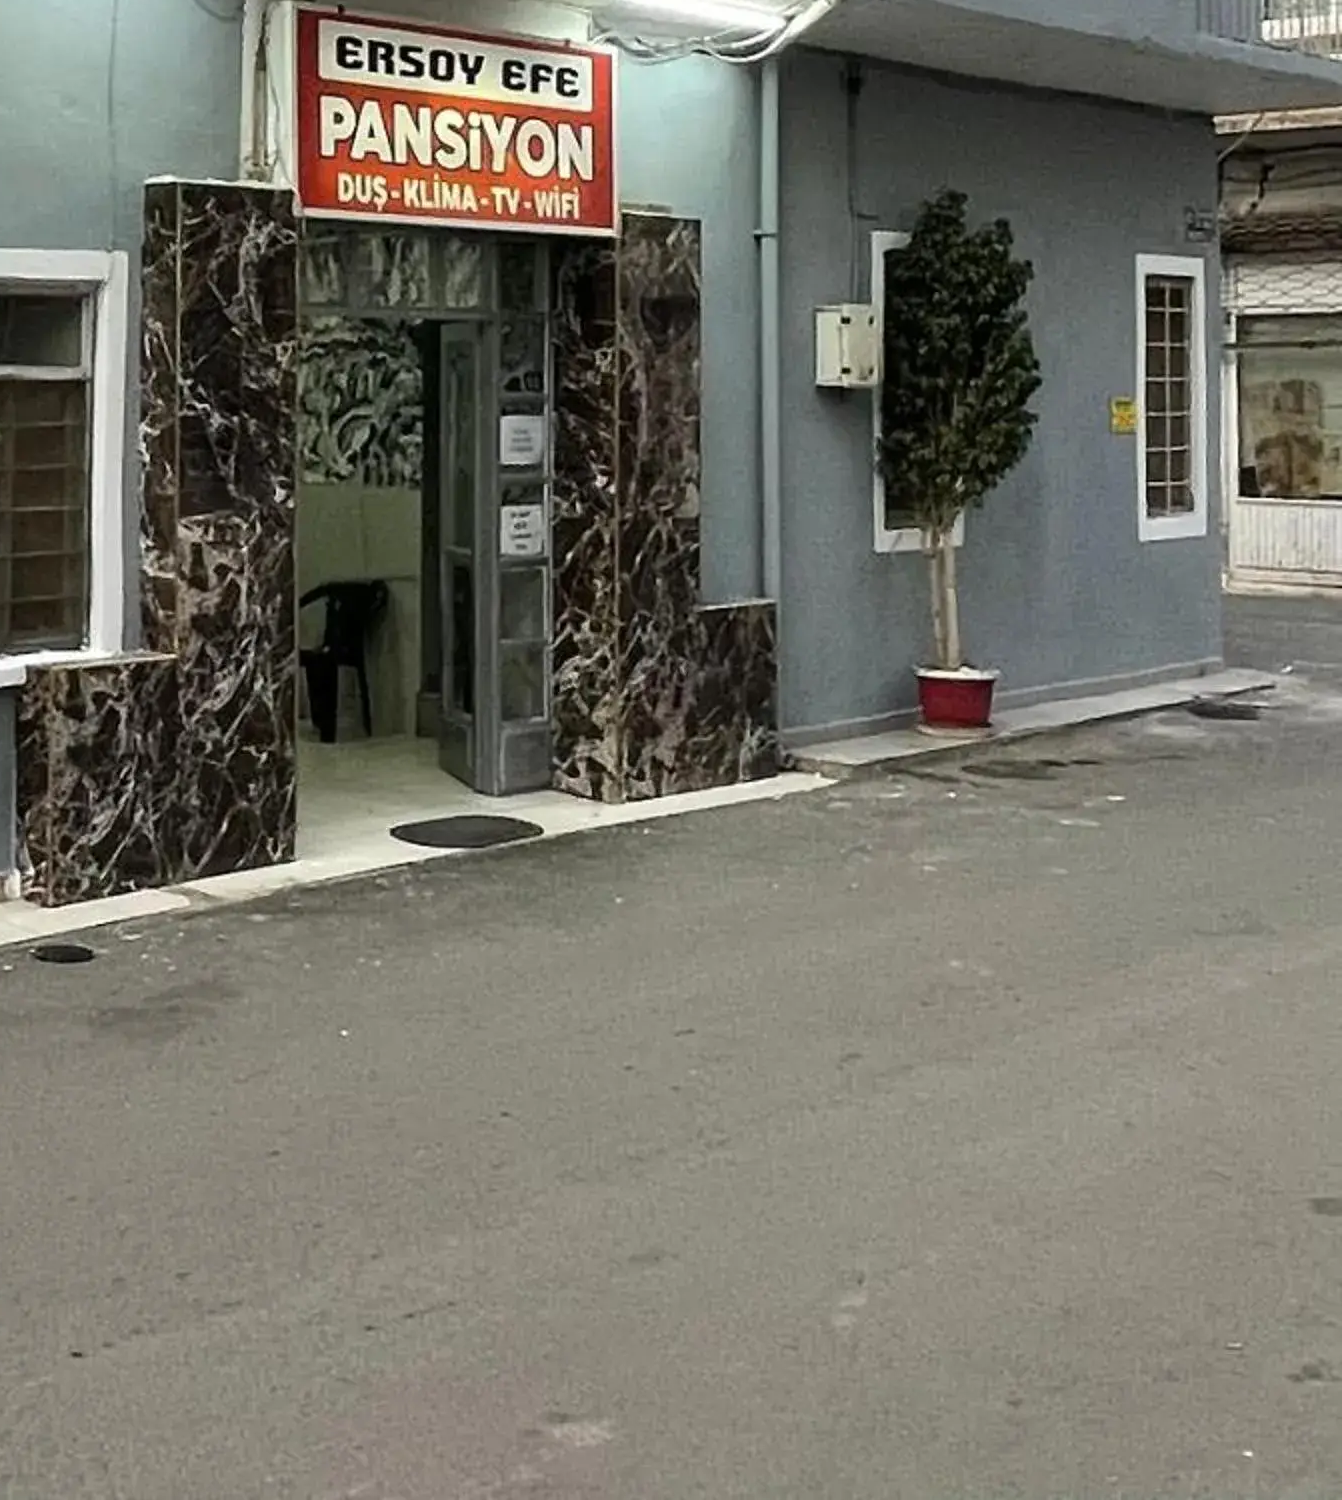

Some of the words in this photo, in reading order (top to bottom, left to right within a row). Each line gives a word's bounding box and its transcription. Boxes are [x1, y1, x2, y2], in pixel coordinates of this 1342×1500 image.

[335, 35, 484, 85] ERSOY
[501, 60, 579, 98] EFE
[337, 172, 388, 212] DUŞ
[403, 171, 478, 214] KLİMA
[490, 186, 520, 216] TV
